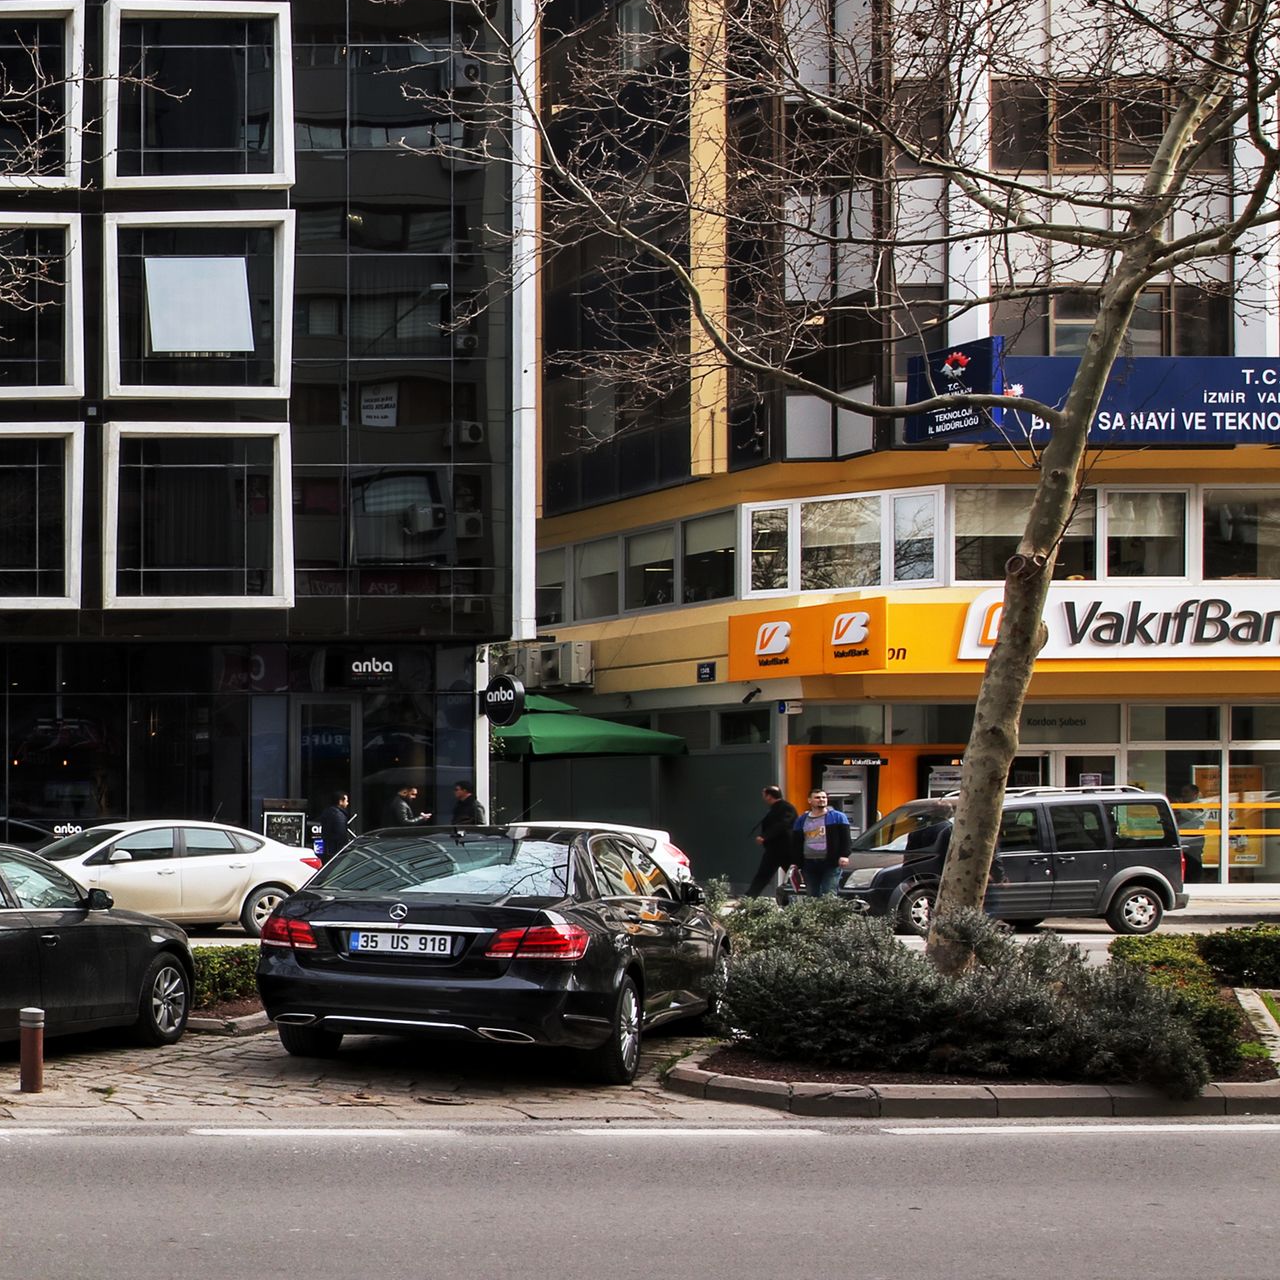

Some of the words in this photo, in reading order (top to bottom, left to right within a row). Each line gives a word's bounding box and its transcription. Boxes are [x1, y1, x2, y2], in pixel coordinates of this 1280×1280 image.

[1203, 390, 1246, 404] İZMİR
[1257, 392, 1280, 404] VA
[1182, 412, 1207, 430] VE
[1212, 411, 1280, 431] TEKNO
[351, 657, 393, 673] anba
[487, 687, 514, 703] anba
[53, 823, 82, 834] anba
[361, 934, 379, 949] 35
[390, 935, 410, 951] US
[418, 936, 447, 952] 918
